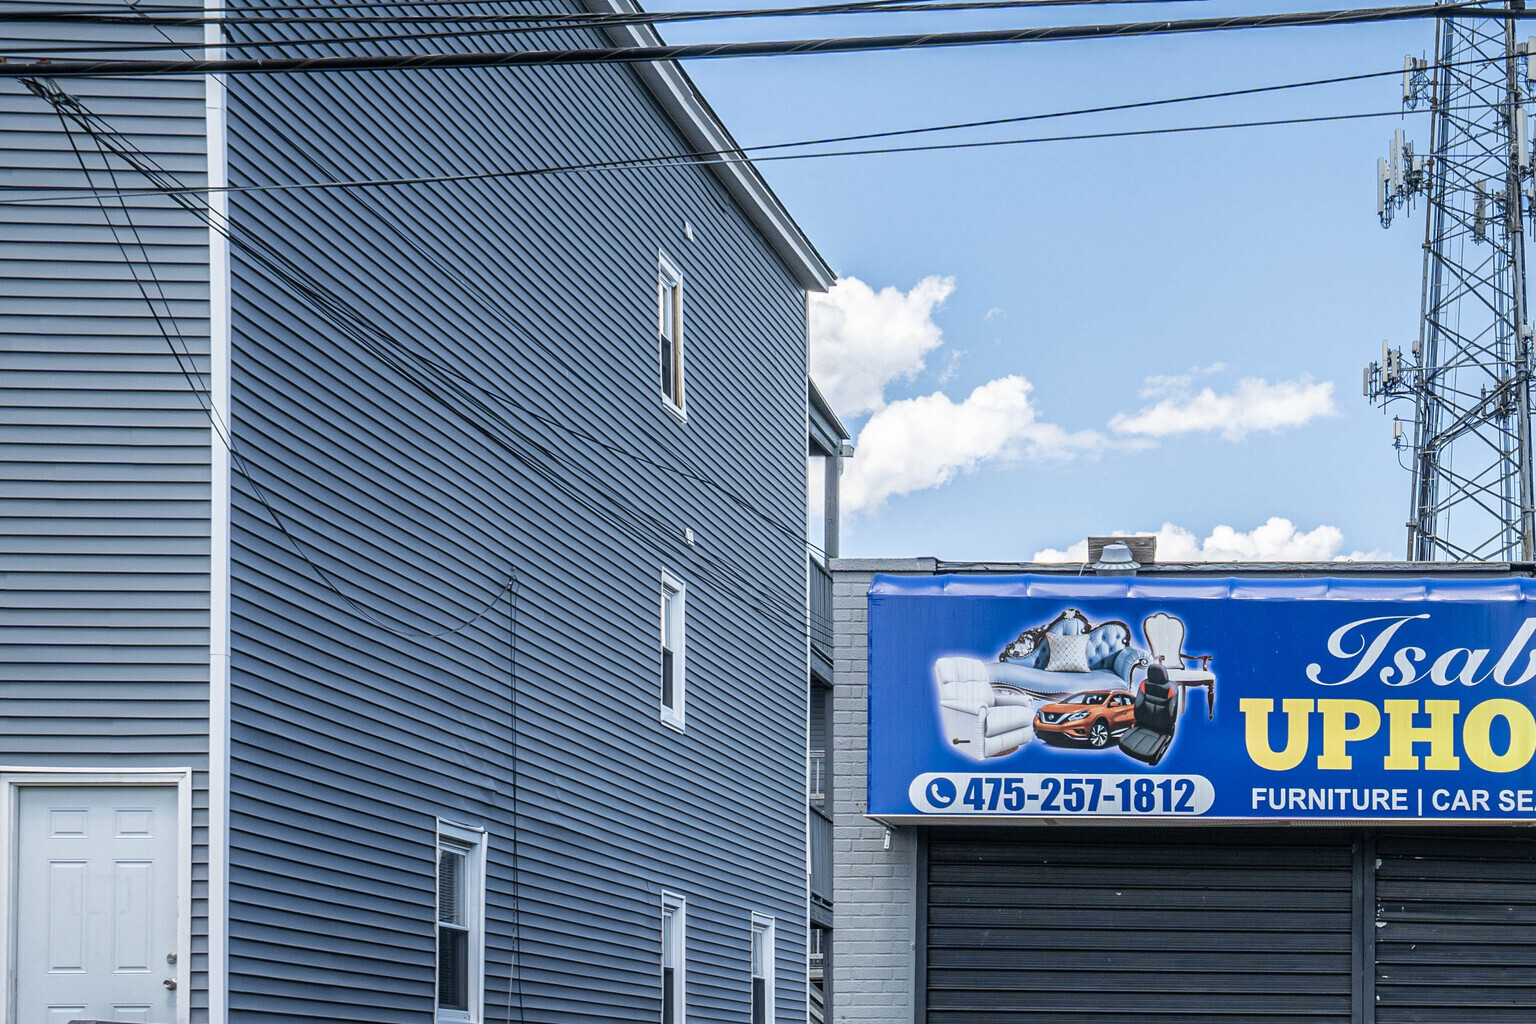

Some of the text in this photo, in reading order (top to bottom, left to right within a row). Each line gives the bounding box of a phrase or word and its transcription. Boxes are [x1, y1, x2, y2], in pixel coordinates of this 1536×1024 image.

[962, 777, 1197, 813] 475-257-1812
[1252, 787, 1409, 811] FURNITURE
[1431, 788, 1491, 812] CAR
